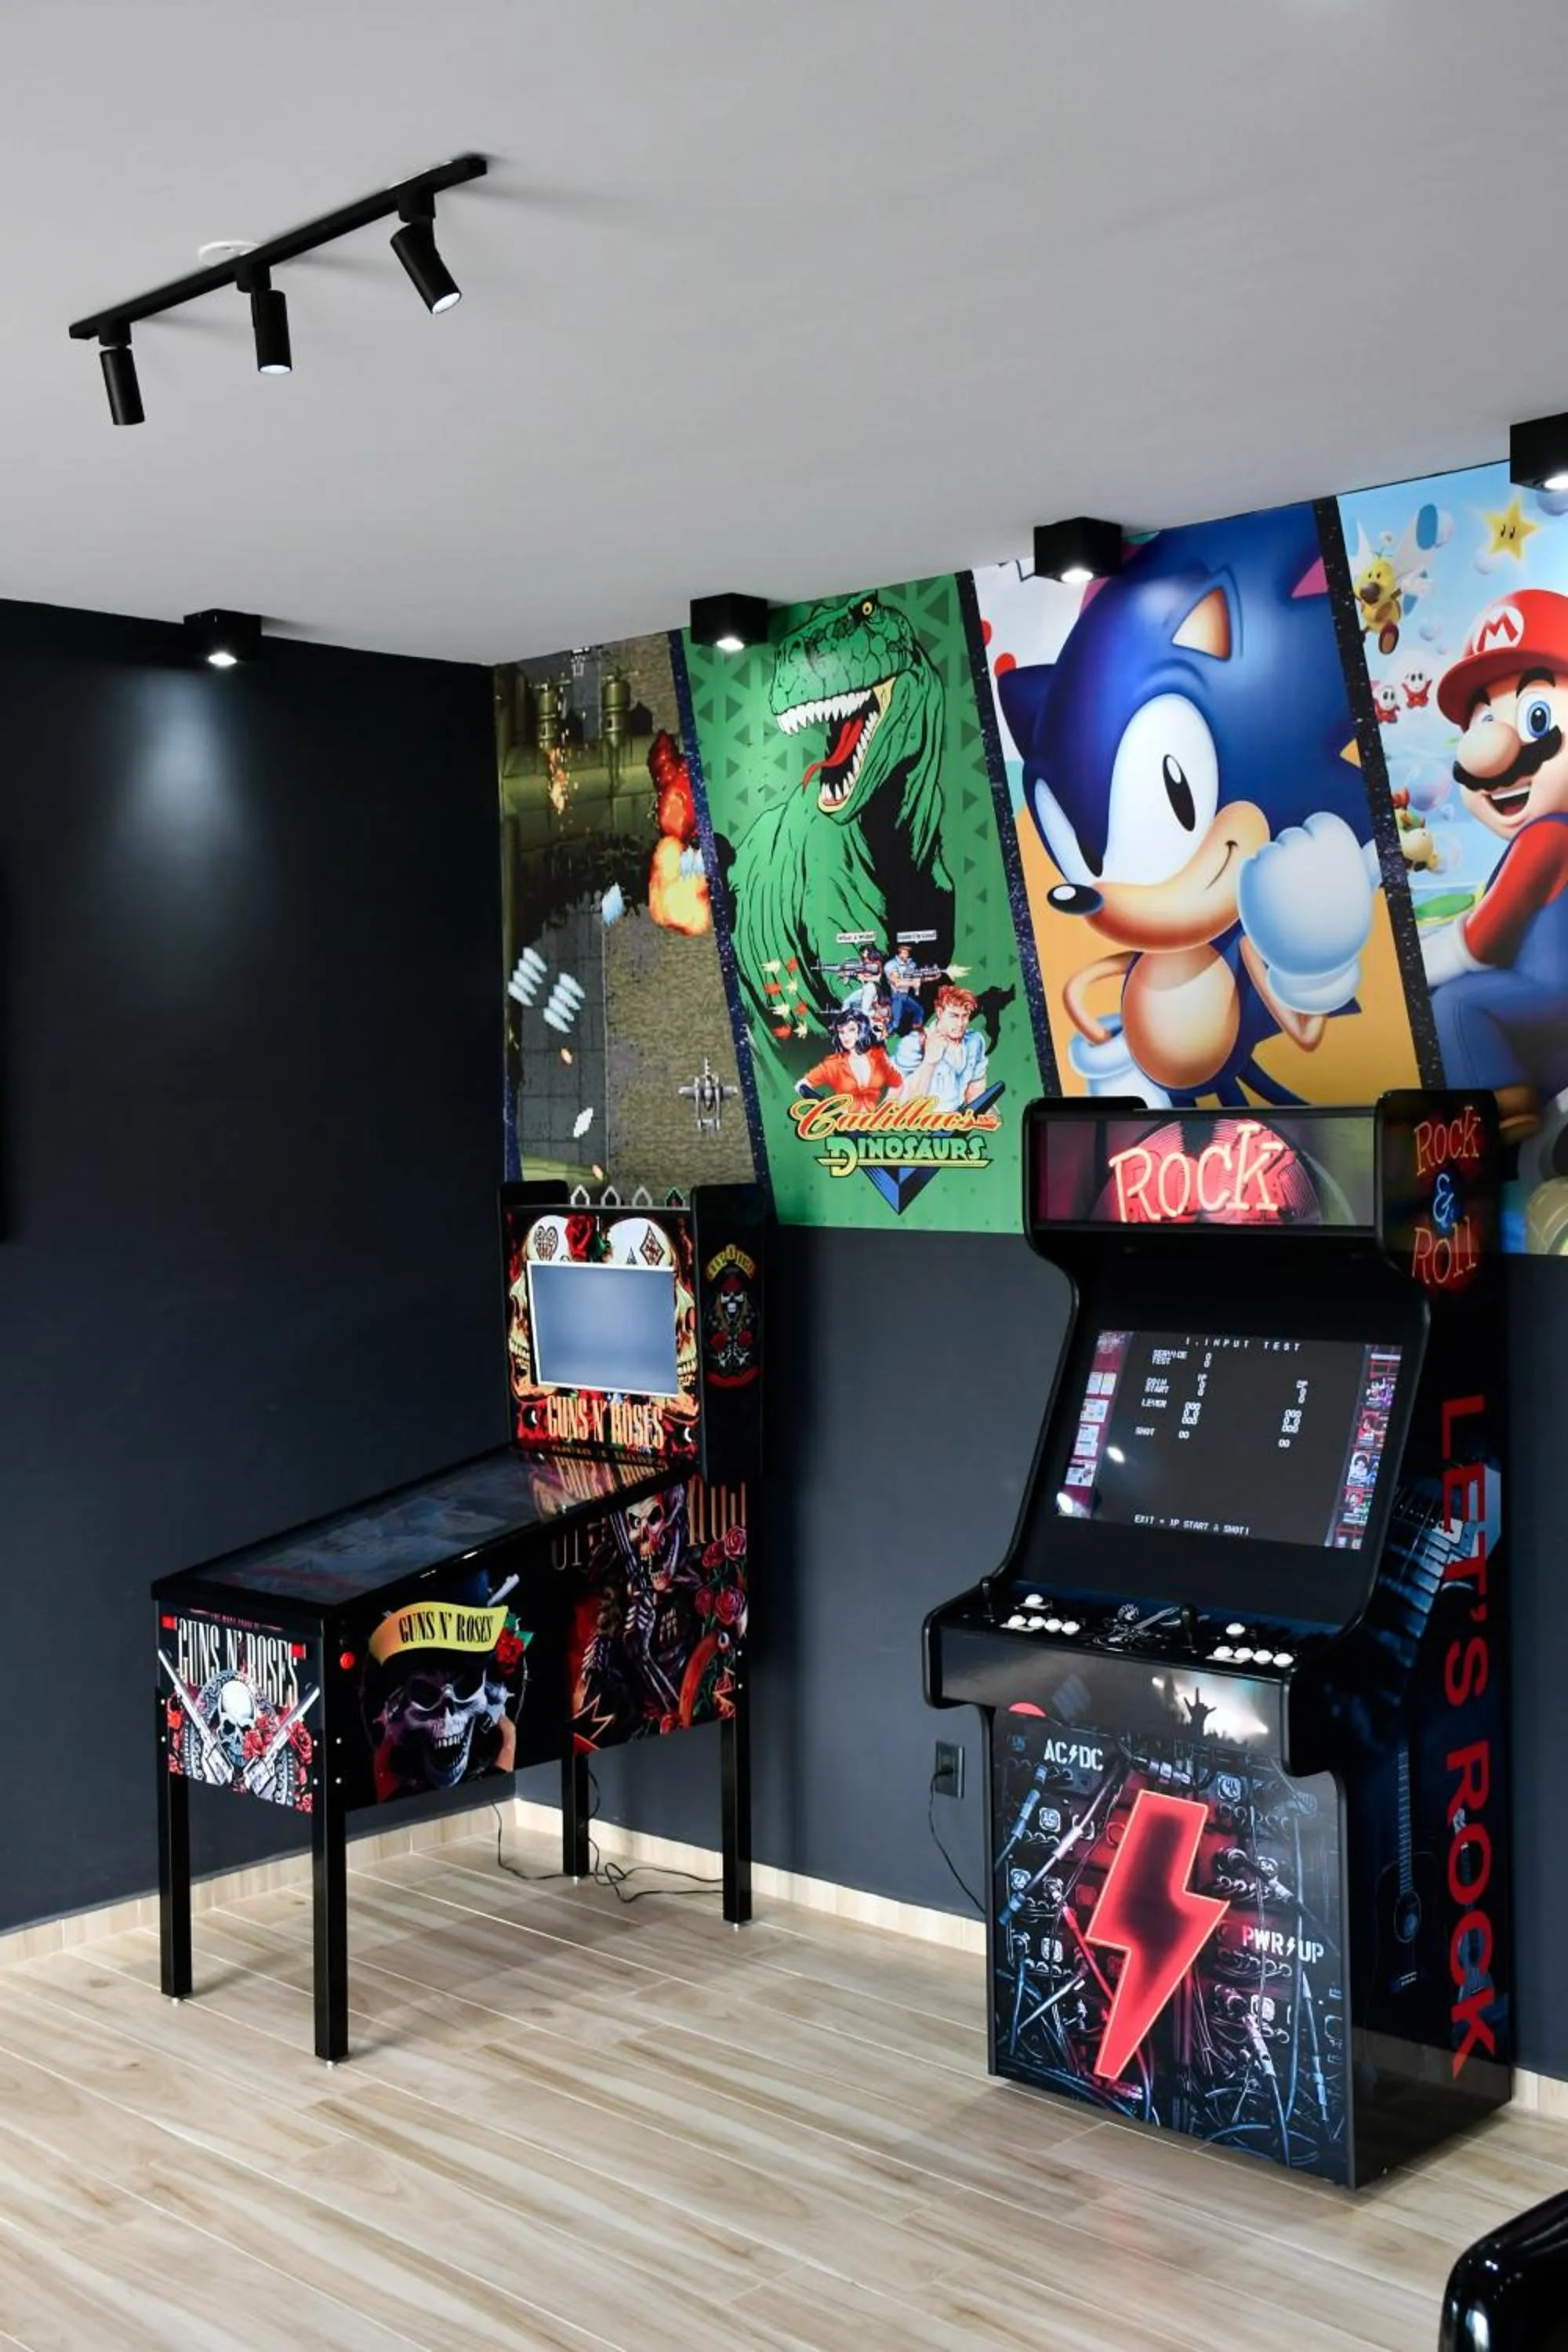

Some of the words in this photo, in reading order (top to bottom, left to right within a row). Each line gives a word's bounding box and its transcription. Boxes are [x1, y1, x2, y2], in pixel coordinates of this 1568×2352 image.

[789, 1094, 977, 1139] Cadillacs
[825, 1136, 987, 1177] DINOSAURS
[1433, 1173, 1454, 1228] &
[1264, 1341, 1301, 1352] TEST
[1145, 1385, 1170, 1394] START
[546, 1395, 589, 1441] GUNS
[609, 1400, 665, 1449] ROSES
[1134, 1514, 1155, 1525] EXIT
[1183, 1519, 1209, 1530] START
[1442, 1394, 1489, 1707] LET'S
[398, 1610, 435, 1643] GUNS
[438, 1610, 452, 1641] N'
[456, 1613, 494, 1643] ROSES
[178, 1617, 222, 1687] GUNS
[245, 1632, 299, 1711] ROSES
[1445, 1738, 1496, 2080] ROCK
[1242, 1926, 1285, 1956] PWR
[1298, 1939, 1324, 1964] UP
